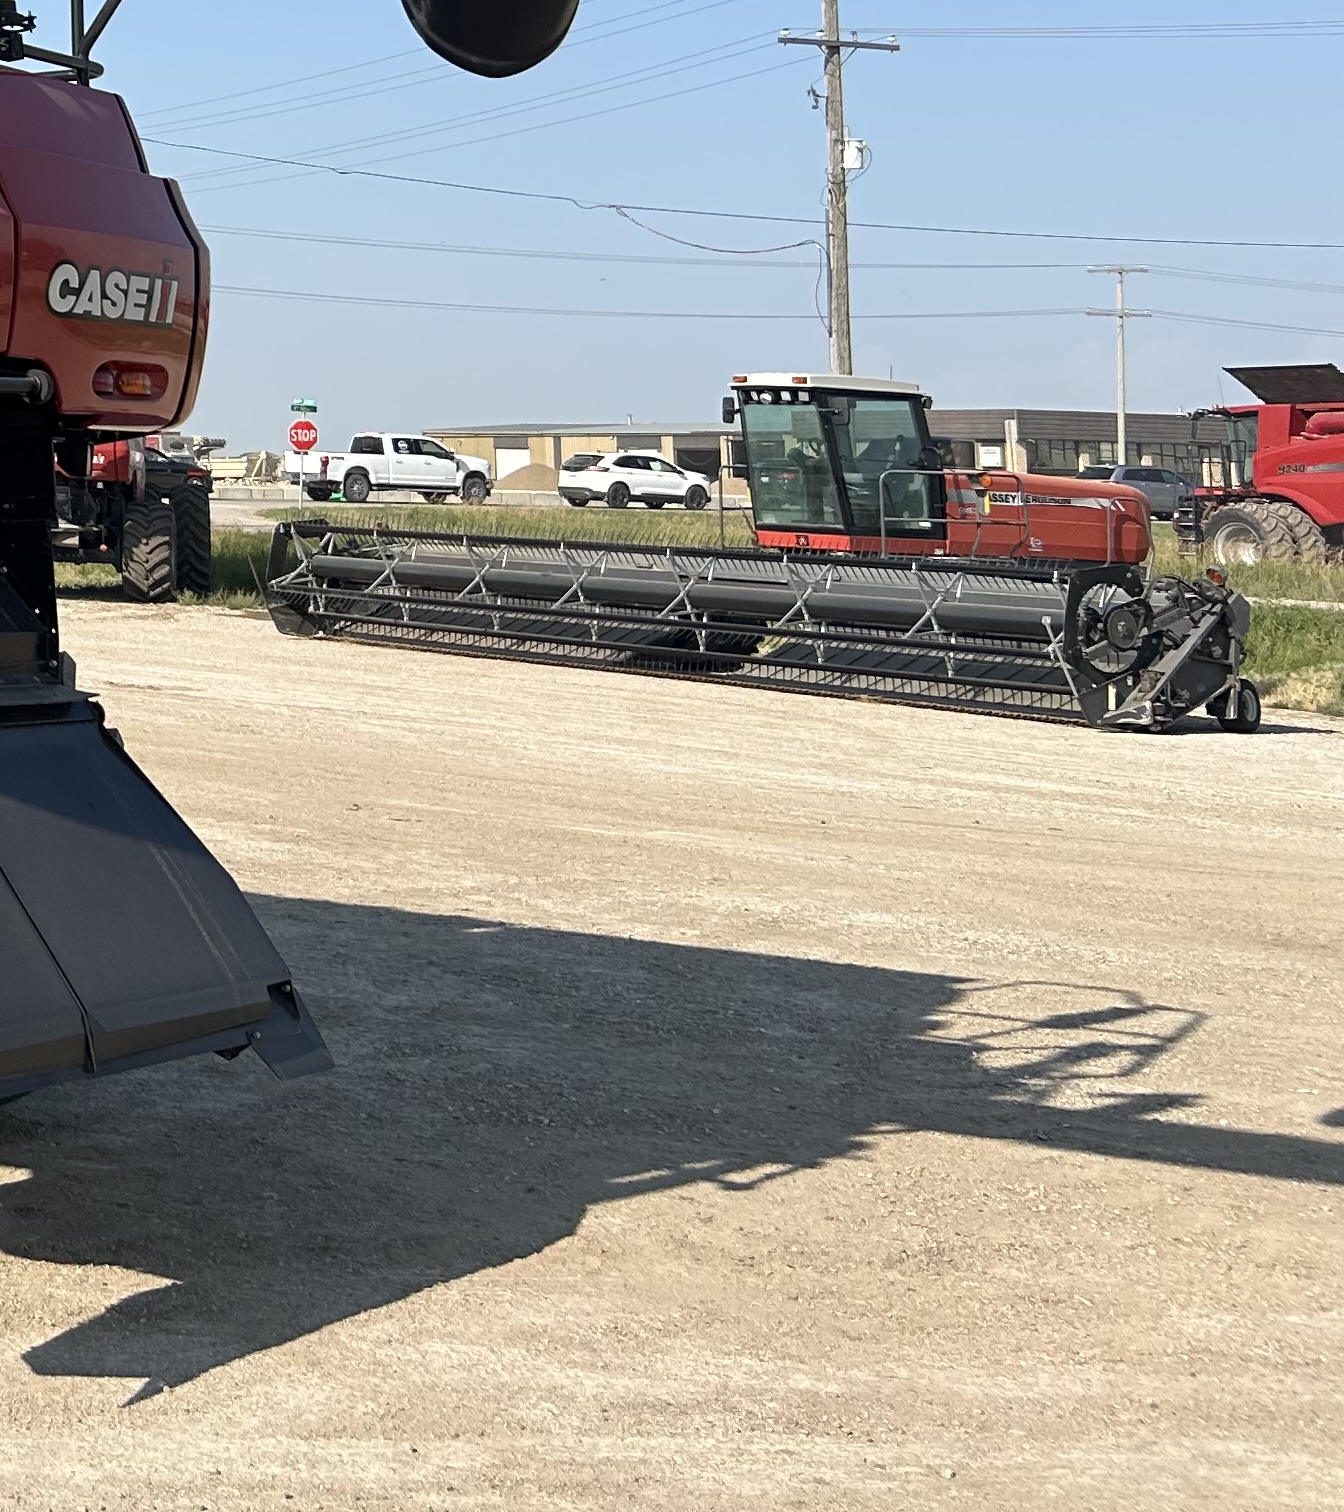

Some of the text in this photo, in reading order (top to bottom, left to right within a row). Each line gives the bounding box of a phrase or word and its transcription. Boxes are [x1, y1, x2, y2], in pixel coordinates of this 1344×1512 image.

[48, 263, 150, 321] CASE
[291, 429, 316, 442] STOP
[1278, 464, 1306, 474] 9240
